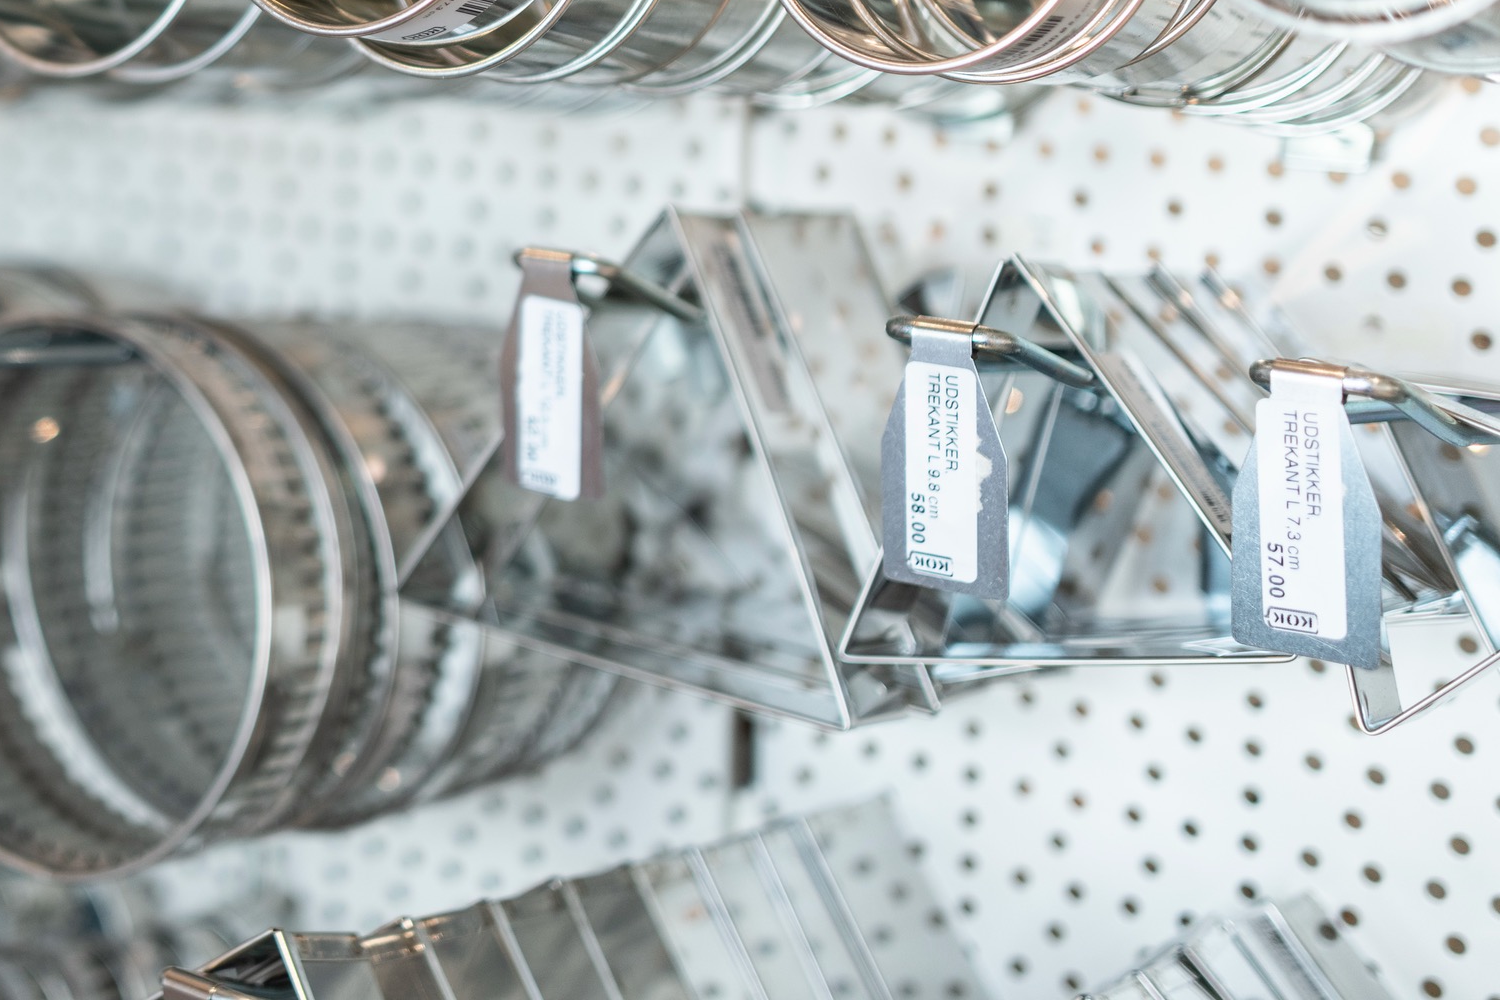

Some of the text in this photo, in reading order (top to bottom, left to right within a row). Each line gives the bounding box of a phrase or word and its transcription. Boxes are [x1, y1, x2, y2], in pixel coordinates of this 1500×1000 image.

[927, 372, 942, 451] TREKANT
[928, 455, 941, 463] L
[1283, 410, 1301, 496] TREKANT
[910, 492, 927, 544] 58.00
[928, 496, 940, 519] cm
[1286, 500, 1300, 509] L
[1267, 542, 1285, 598] 57.00
[1287, 545, 1301, 570] cm
